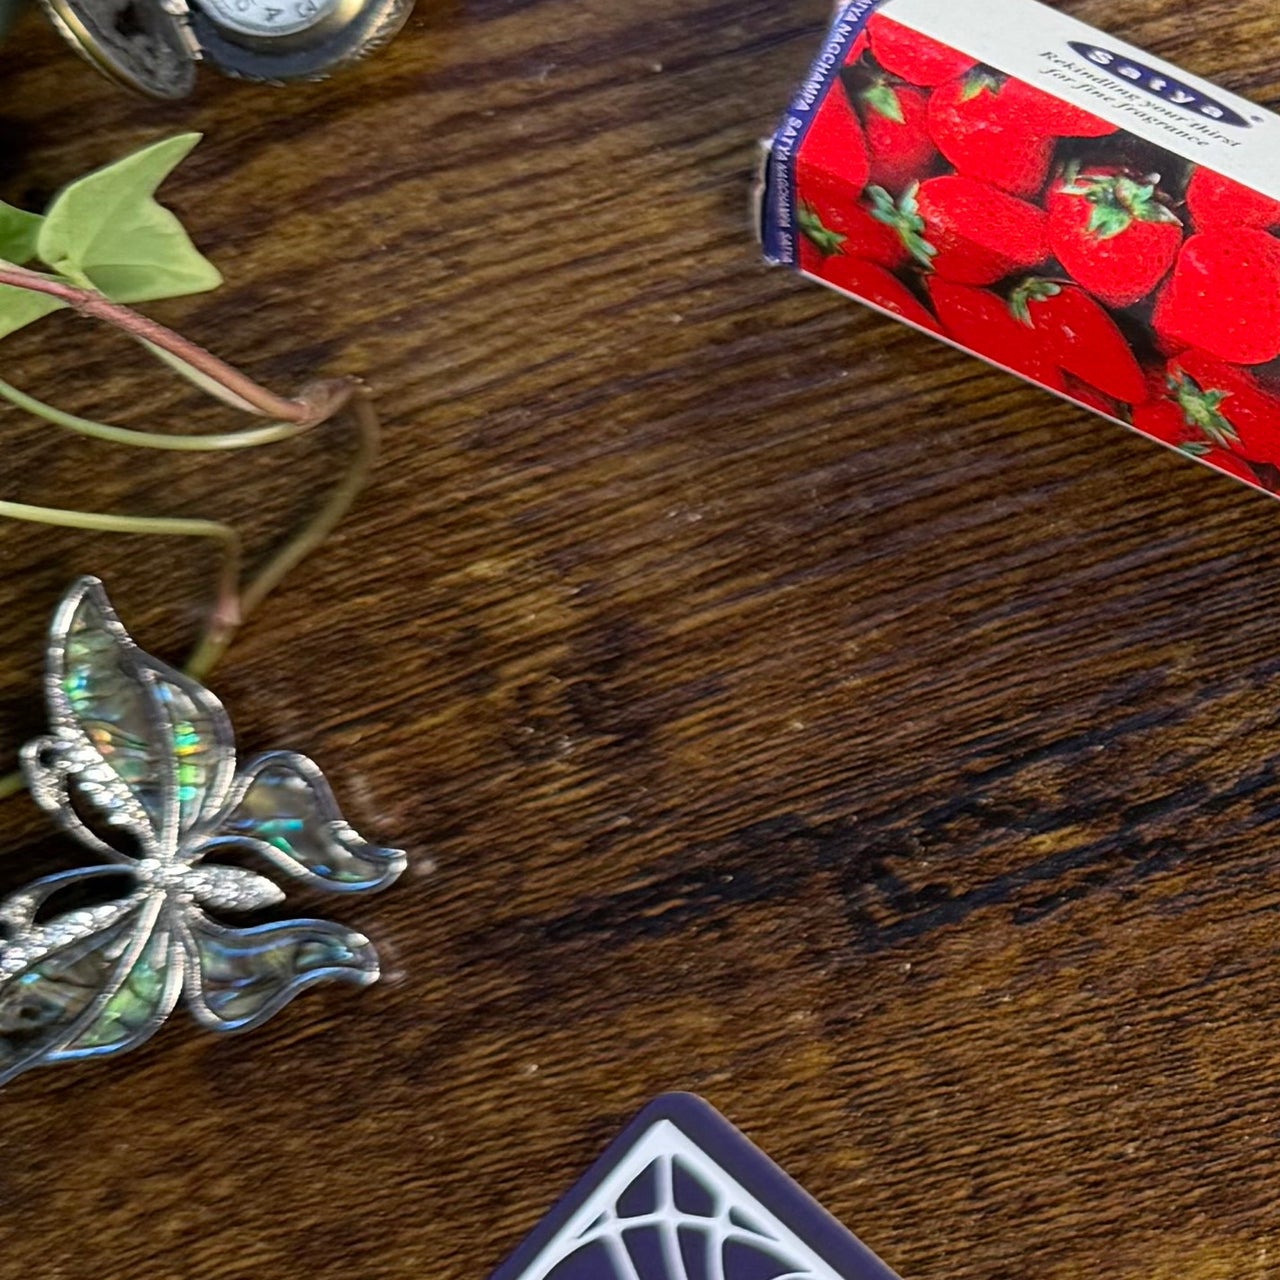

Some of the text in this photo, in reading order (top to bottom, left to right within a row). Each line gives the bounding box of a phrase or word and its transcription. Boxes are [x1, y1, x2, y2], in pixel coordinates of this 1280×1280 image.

[1038, 51, 1243, 148] Rekindling your thirst
[1039, 68, 1211, 147] for fine fragrance
[1087, 49, 1225, 119] Satya
